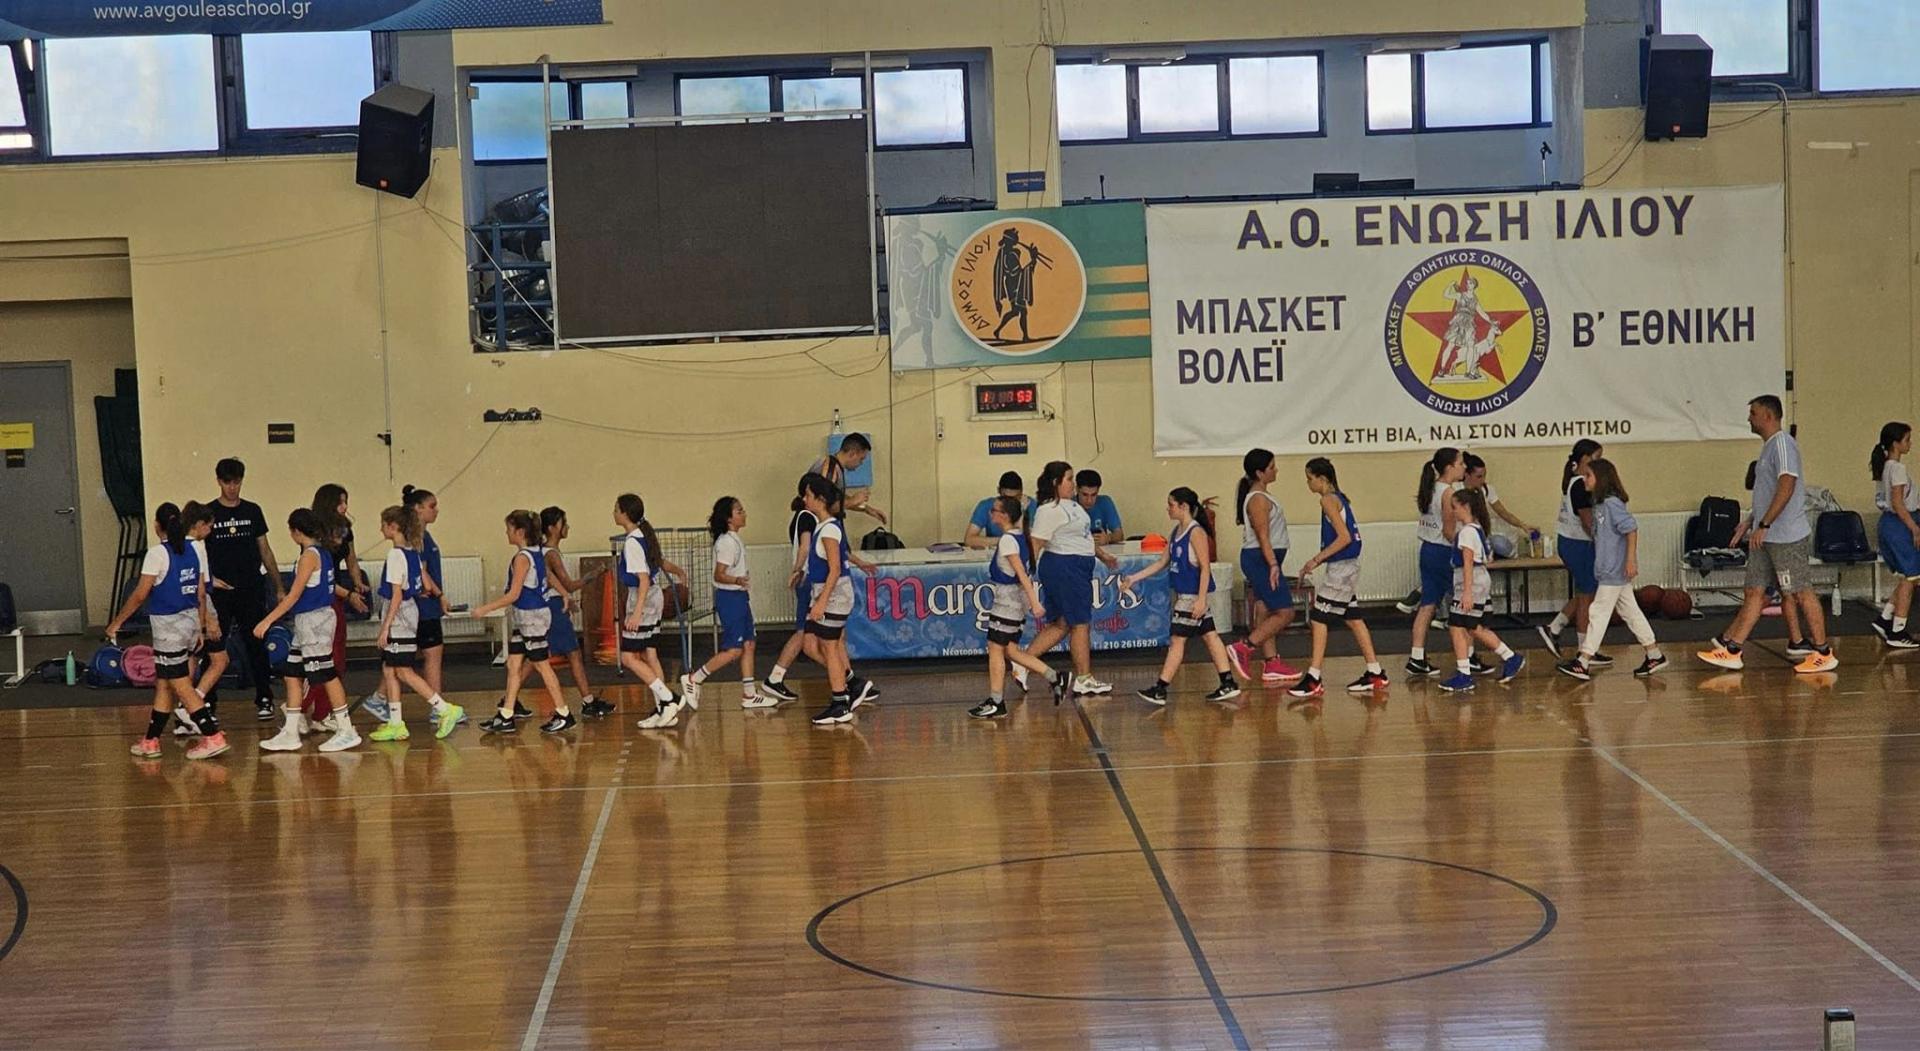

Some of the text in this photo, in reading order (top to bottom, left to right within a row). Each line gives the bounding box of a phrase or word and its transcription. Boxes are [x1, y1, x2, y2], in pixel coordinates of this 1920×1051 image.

[93, 0, 312, 22] www.avgouleaschool.gr
[1237, 195, 1695, 250] Α.Ο. ΕΝΩΣΗ ΙΛΙΟΥ
[958, 234, 991, 330] ΔΗΜΟΣ ΙΛΙΟΥ
[1406, 252, 1529, 290] ΑΘΛΗΤΙΚΟΣ ΟΜΙΛΟΣ
[1176, 295, 1347, 335] ΜΠΑΣΚΕΤ
[1387, 301, 1404, 367] ΜΠΑΣΚΕΤ
[1620, 306, 1755, 346] ΕΘΝΙΚΗ
[1178, 338, 1287, 384] ΒΟΛΕΪ
[1426, 391, 1511, 414] ΕΝΩΣΗ ΙΛΙΟΥ
[1308, 420, 1632, 445] ΟΧΙ ΣΤΗ ΒΙΑ, ΝΑΙ ΣΤΟΝ ΑΘΛΗΤΙΣΜΟ
